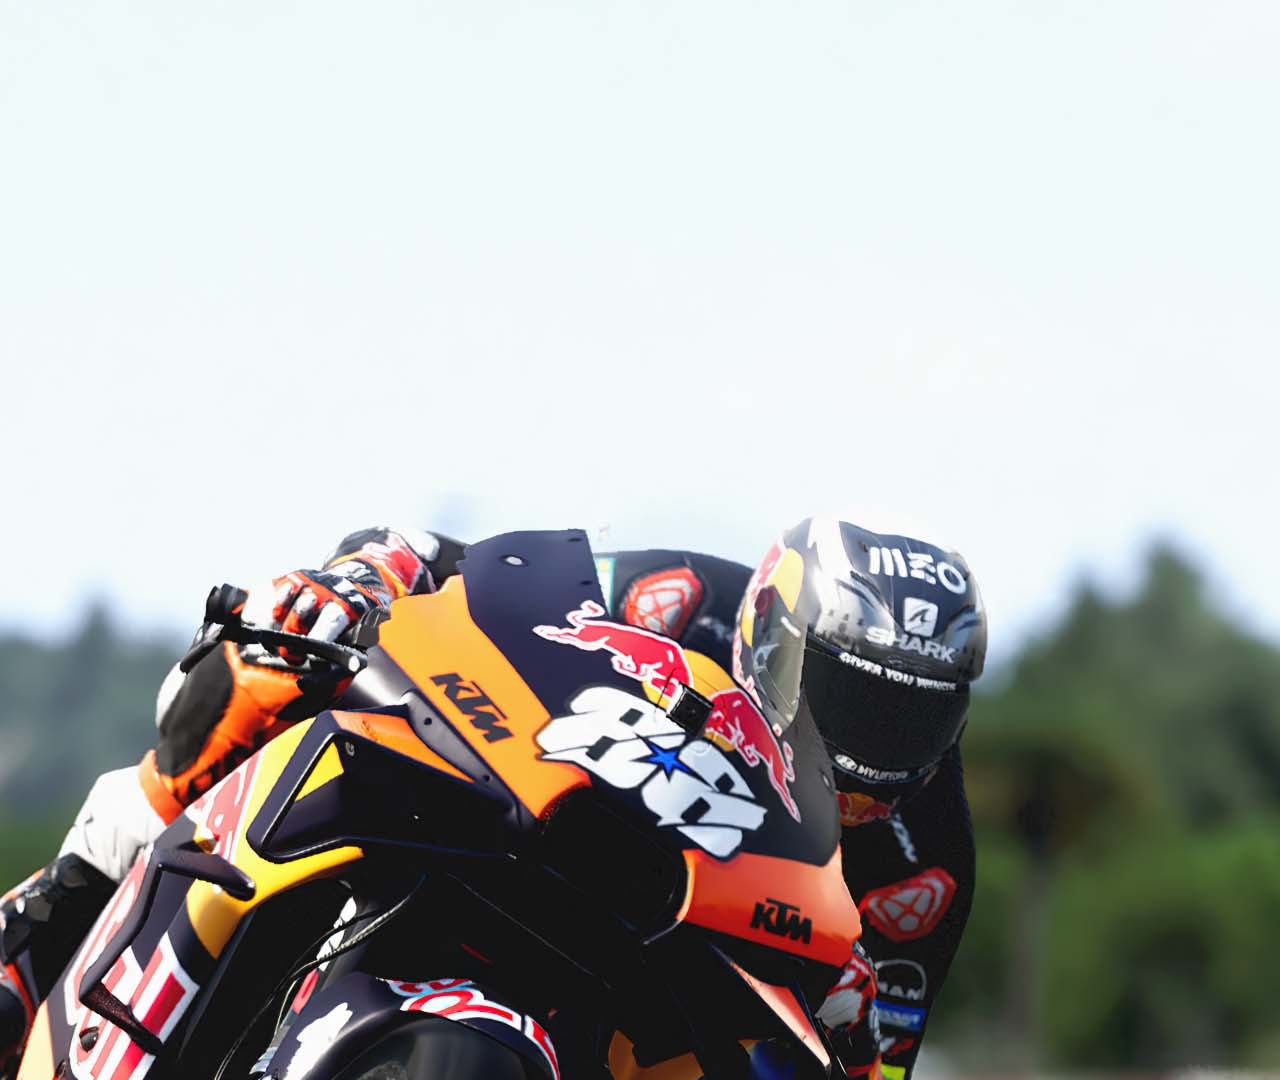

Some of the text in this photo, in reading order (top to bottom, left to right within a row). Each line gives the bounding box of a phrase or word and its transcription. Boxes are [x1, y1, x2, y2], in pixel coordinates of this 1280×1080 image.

[865, 627, 955, 663] SHARK
[430, 674, 514, 743] KTM
[535, 686, 767, 858] 88
[749, 898, 812, 944] KTM
